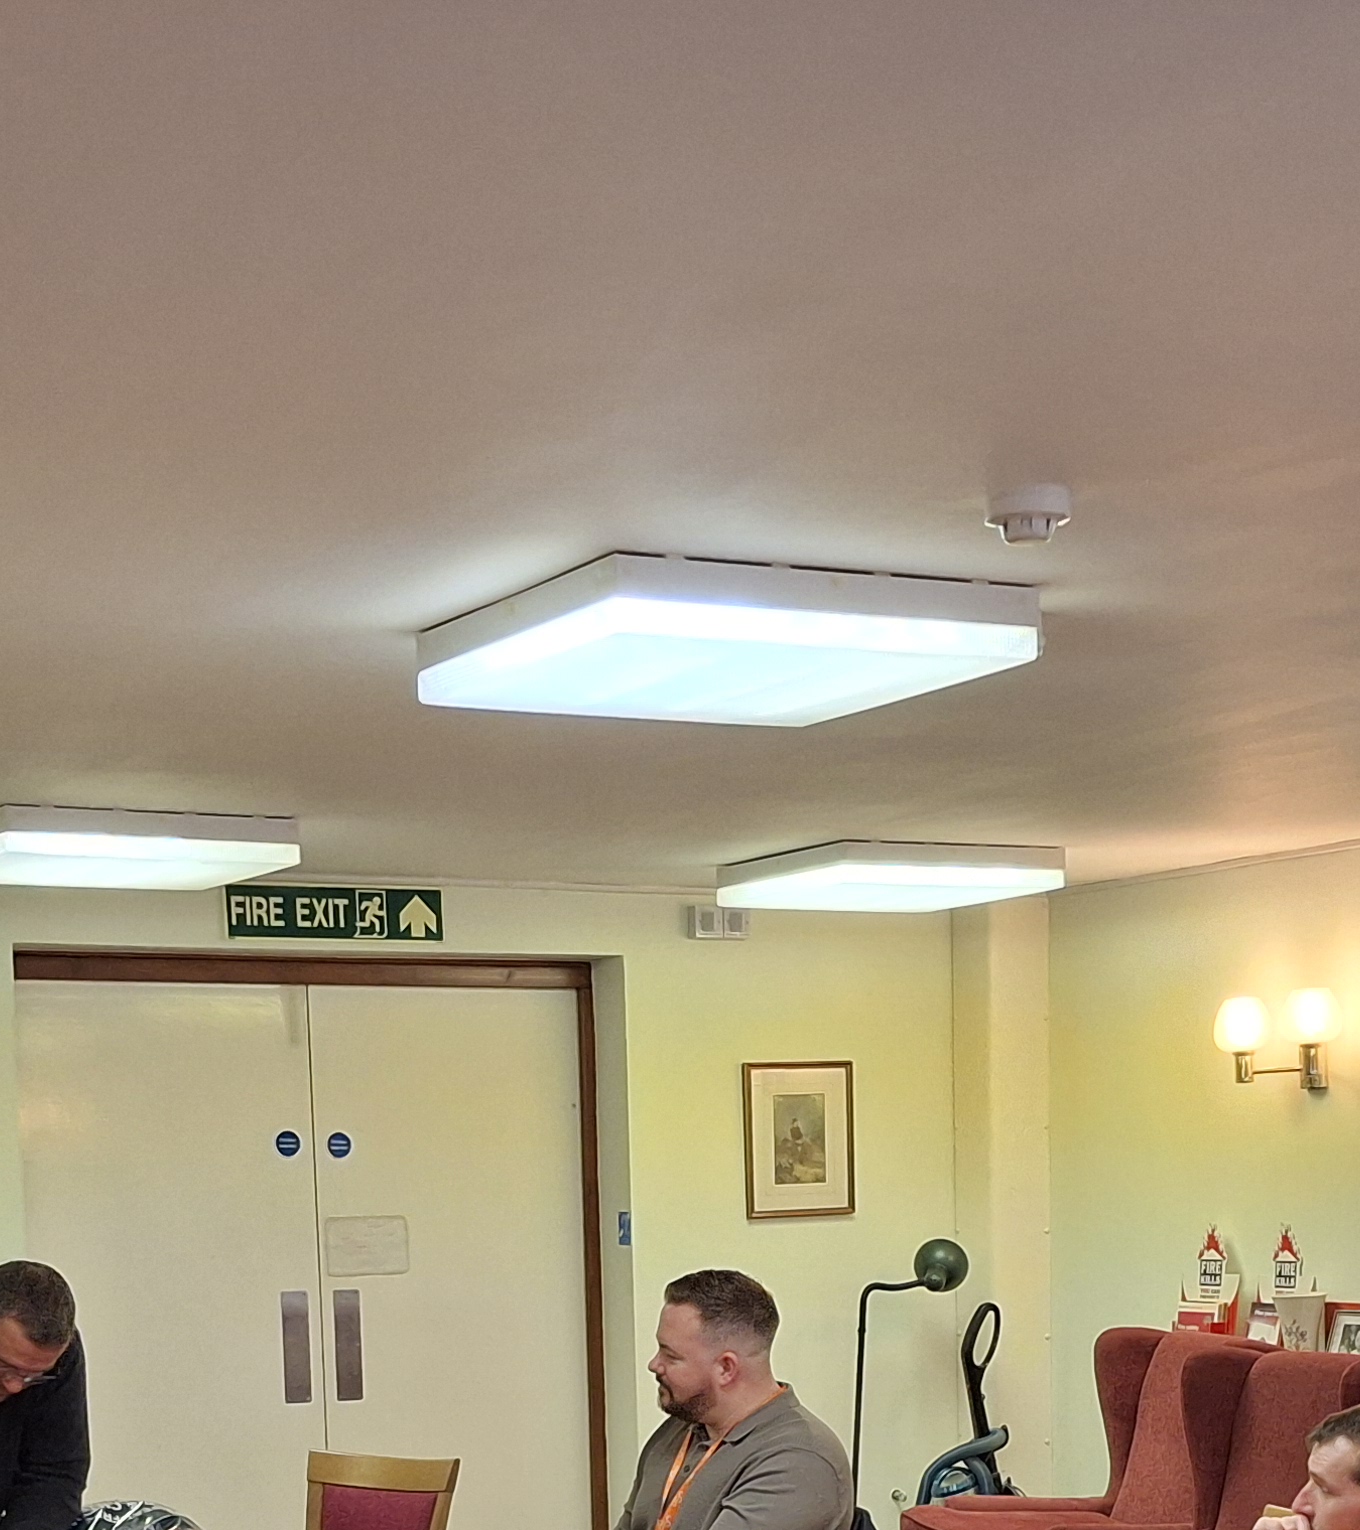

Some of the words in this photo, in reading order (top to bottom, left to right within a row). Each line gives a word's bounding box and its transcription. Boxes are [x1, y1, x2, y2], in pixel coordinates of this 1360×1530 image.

[230, 895, 286, 927] FIRE
[295, 898, 349, 928] EXIT
[1201, 1261, 1222, 1274] FIRE
[1276, 1263, 1296, 1276] FIRE
[1200, 1275, 1221, 1285] KILLS
[1276, 1277, 1295, 1287] KILLS
